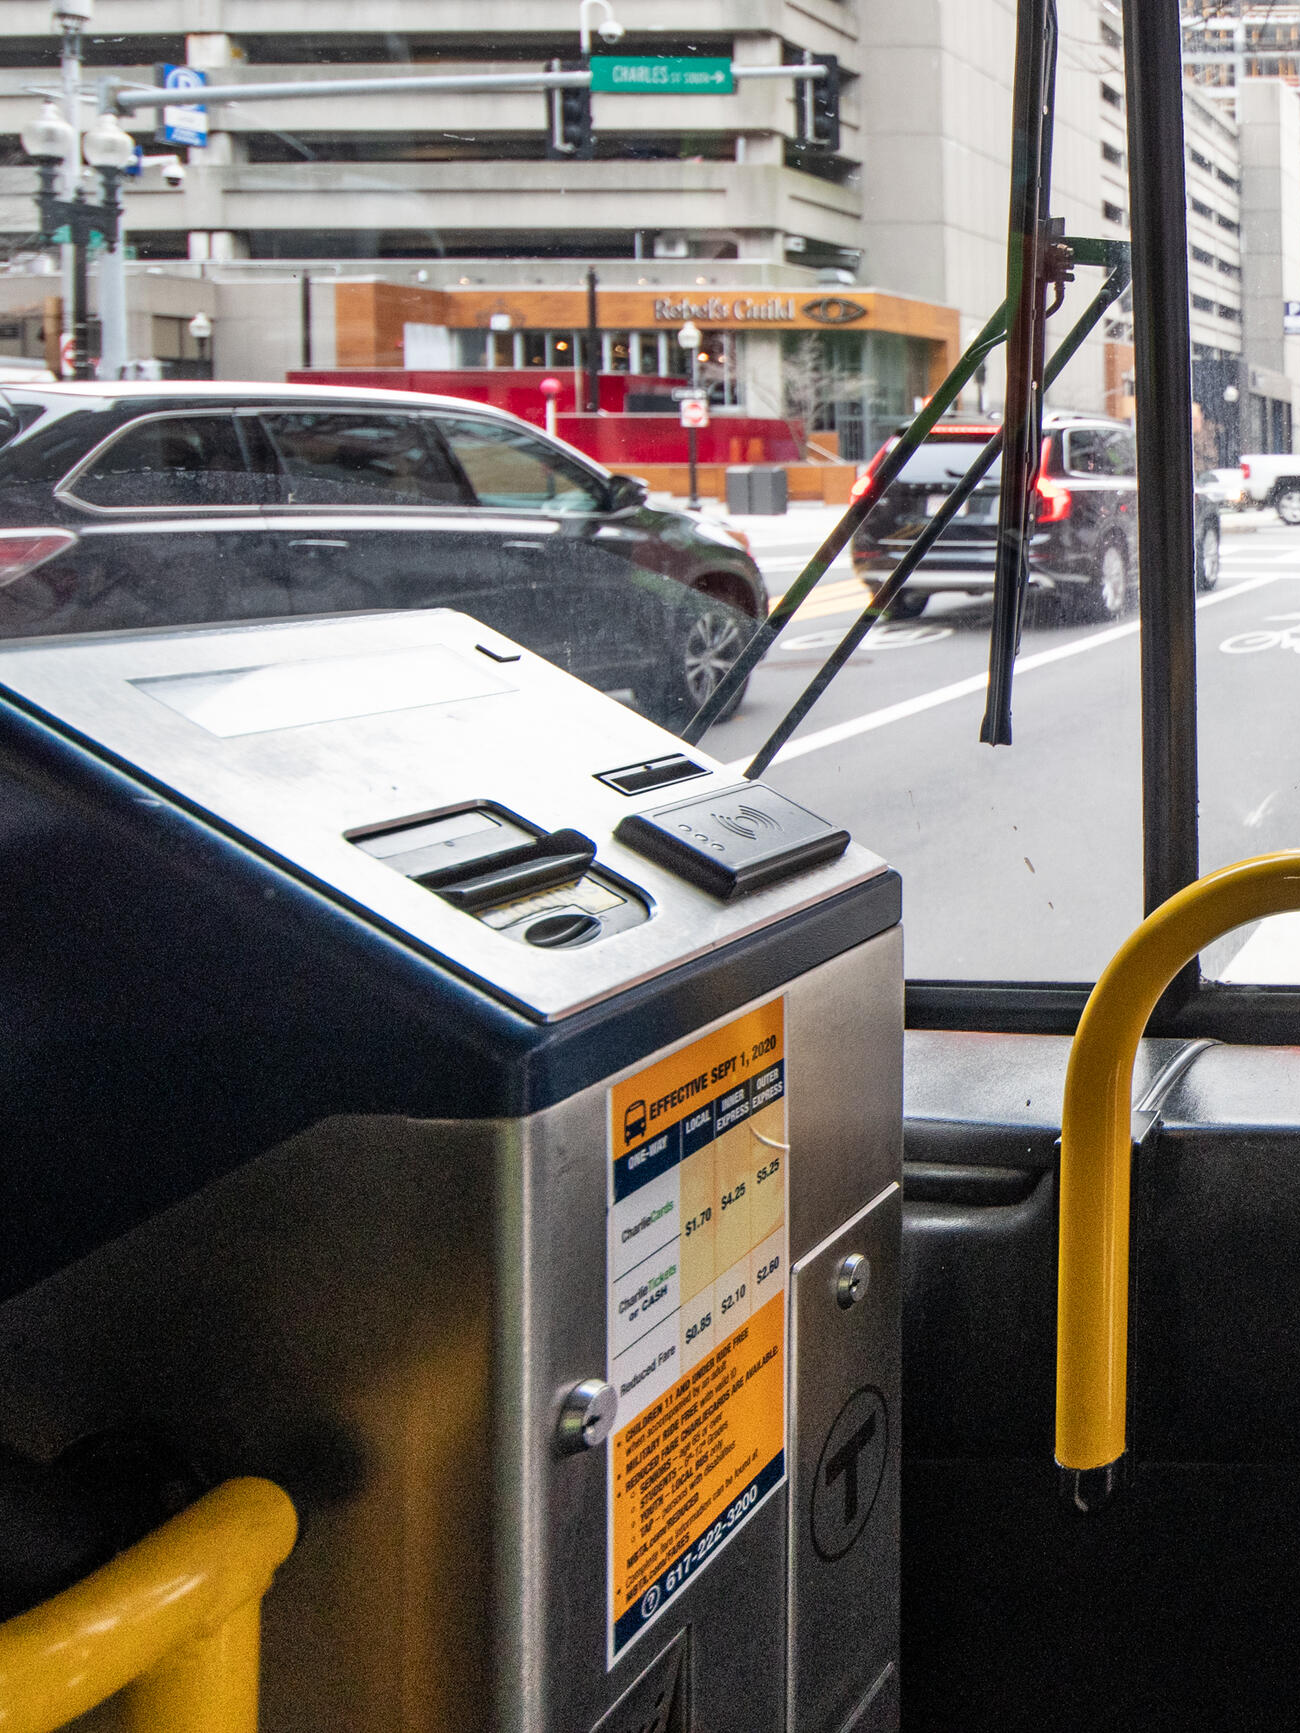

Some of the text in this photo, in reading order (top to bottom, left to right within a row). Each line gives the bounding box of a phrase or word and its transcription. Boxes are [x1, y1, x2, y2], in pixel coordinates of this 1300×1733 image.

[612, 65, 668, 84] CHARLES
[655, 297, 795, 321] Rebel's Guild
[649, 1033, 775, 1121] EFFECTIVE SEPT 1, 2020
[752, 1079, 782, 1109] EXPRESS
[756, 1066, 778, 1091] OUTER
[716, 1100, 749, 1132] EXPRESS
[721, 1087, 744, 1113] INNER
[685, 1107, 710, 1135] LOCAL
[628, 1134, 667, 1171] ONE-WAY
[756, 1156, 779, 1186] $5.25
[721, 1180, 745, 1212] $4.25
[621, 1197, 673, 1245] CharlieCards
[685, 1205, 711, 1238] $1.70
[618, 1261, 676, 1316] CharlieTickets
[628, 1283, 667, 1323] or CASH
[721, 1282, 745, 1315] $2.10
[685, 1310, 711, 1346] $0.85
[620, 1342, 675, 1399] Reduced Fare
[625, 1326, 748, 1444] CHILDREN 11 AND UNDER RIDE FREE
[692, 1383, 699, 1400] by
[626, 1453, 659, 1494] REDUCED
[661, 1434, 678, 1461] FARE
[680, 1387, 729, 1444] CHARLIECARDS
[731, 1375, 743, 1395] ARE
[626, 1434, 659, 1476] MILITARY
[662, 1417, 678, 1442] RIDE
[681, 1399, 698, 1425] FREE
[640, 1456, 670, 1496] SENIORS
[640, 1492, 663, 1525] YOUTH
[671, 1463, 693, 1495] LOCAL
[695, 1449, 708, 1472] BUS
[640, 1466, 676, 1511] STUDENTS
[666, 1484, 759, 1592] 617-222-3200
